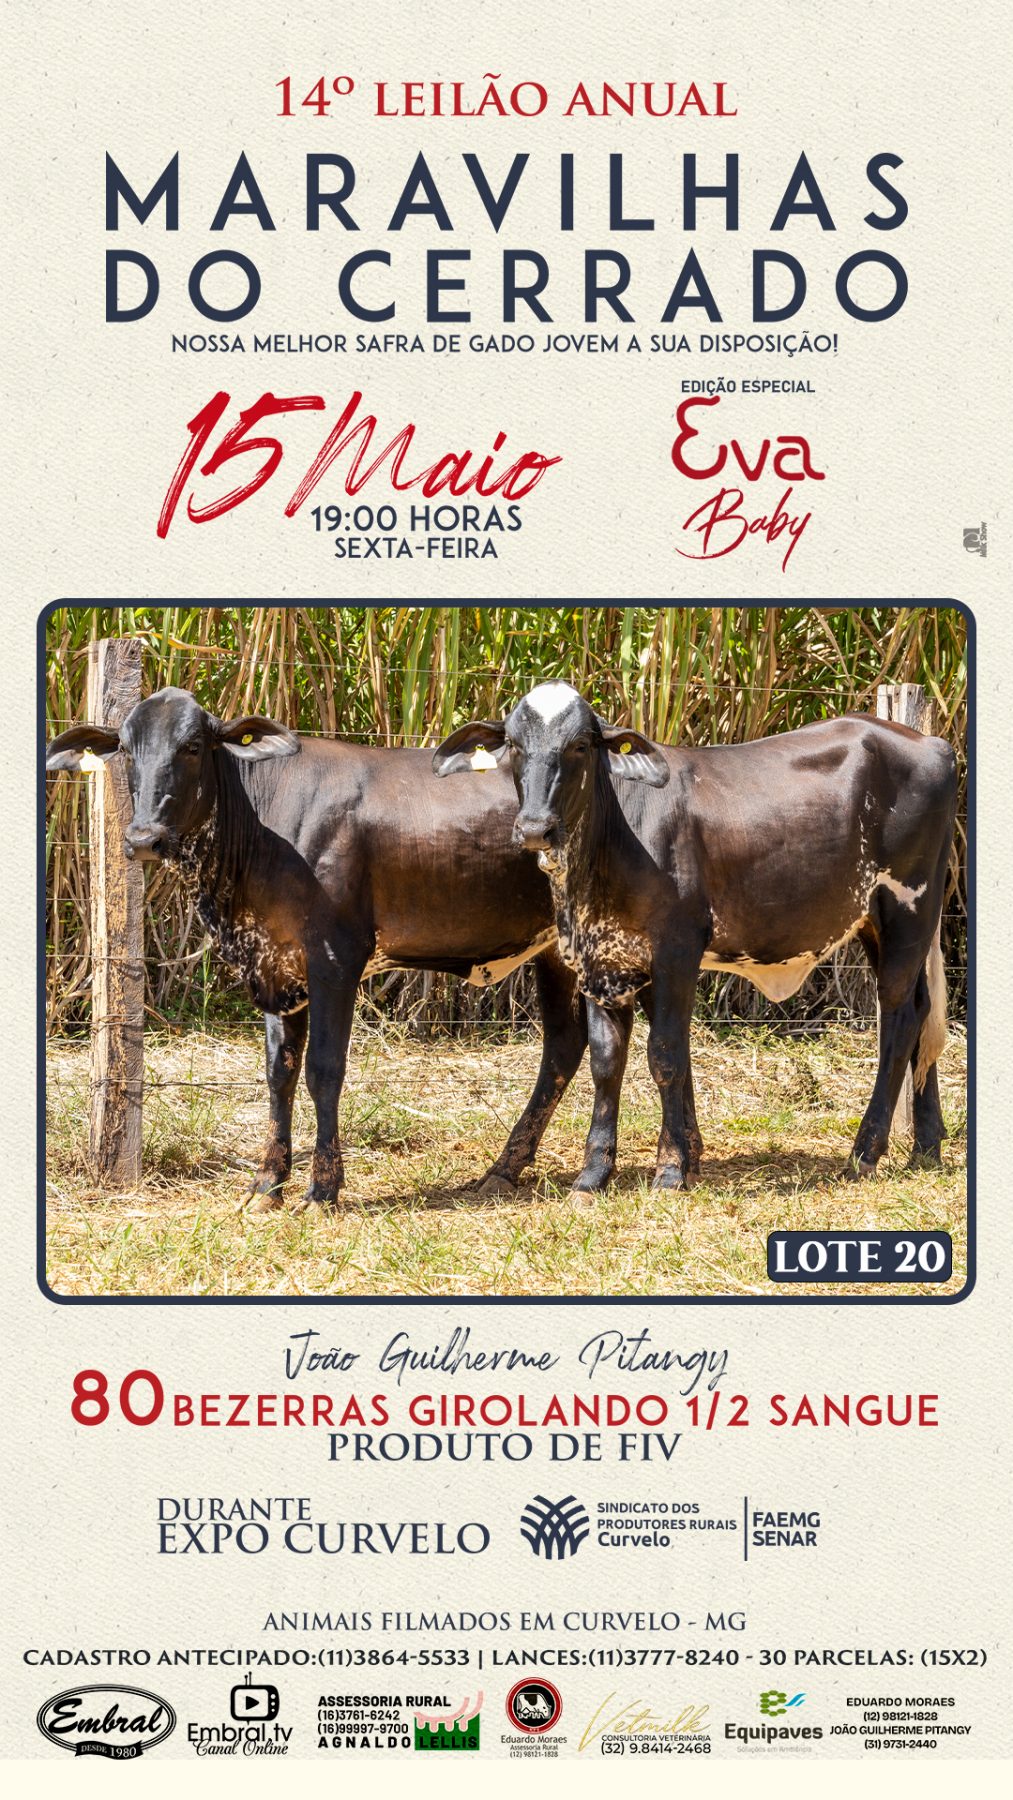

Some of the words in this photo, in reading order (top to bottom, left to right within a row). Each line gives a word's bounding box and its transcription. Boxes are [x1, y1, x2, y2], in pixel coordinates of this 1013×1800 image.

[373, 72, 549, 117] LEILÃO
[562, 81, 738, 117] ANUAL
[105, 150, 909, 234] MARAVILHAS
[105, 249, 262, 323] DO
[338, 247, 909, 323] CERRADO
[171, 334, 246, 353] NOSSA
[253, 334, 348, 353] MELHOR
[355, 334, 426, 353] SAFRA
[433, 334, 461, 353] DE
[468, 334, 535, 353] GADO
[542, 334, 619, 353] JOVEM
[626, 334, 642, 353] A
[650, 334, 692, 353] SUA
[700, 330, 838, 358] DISPOSIÇÃO!
[681, 376, 737, 398] EDIÇÃO
[741, 379, 816, 393] ESPECIAL
[671, 396, 826, 481] Eva
[156, 391, 326, 540] 15
[284, 391, 562, 517] Maio
[310, 504, 398, 532] 19:00
[410, 504, 523, 532] HORAS
[675, 486, 812, 573] Baby
[334, 536, 499, 559] SEXTA-FEIRA
[774, 1239, 882, 1274] LOTE
[893, 1239, 946, 1275] 20
[283, 1331, 361, 1380] João
[378, 1329, 560, 1375] Guilherme
[577, 1328, 731, 1397] Pitangy
[70, 1369, 165, 1427] 80
[173, 1393, 390, 1427] BEZERRAS
[408, 1393, 669, 1427] GIROLANDO
[686, 1393, 751, 1431] 1/2
[769, 1393, 939, 1427] SANGUE
[327, 1432, 533, 1462] PRODUTO
[548, 1432, 602, 1462] DE
[618, 1433, 683, 1462] FIV
[157, 1497, 312, 1521] DURANTE
[597, 1502, 669, 1514] SINDICATO
[672, 1503, 700, 1514] DOS
[597, 1518, 686, 1531] PRODUTORES
[689, 1519, 738, 1531] RURAIS
[752, 1511, 821, 1528] FAEMG
[157, 1522, 269, 1554] EXPO
[284, 1522, 491, 1554] CURVELO
[597, 1530, 671, 1548] Curvelo
[752, 1530, 818, 1547] SENAR
[262, 1611, 372, 1631] ANIMAIS
[382, 1611, 511, 1631] FILMADOS
[520, 1612, 555, 1631] EM
[563, 1611, 681, 1631] CURVELO
[705, 1611, 746, 1631] MG
[22, 1649, 151, 1666] CADASTRO
[759, 1649, 787, 1666] 30
[794, 1649, 914, 1666] PARCELAS:
[920, 1648, 988, 1668] (15X2)
[317, 1695, 403, 1708] ASSESSORIA
[405, 1695, 452, 1708] RURAL
[846, 1697, 903, 1707] EDUARDO
[905, 1697, 956, 1707] MORAES
[48, 1698, 164, 1734] Embral
[317, 1708, 401, 1722] (16)3761-6242
[578, 1691, 712, 1752] Vetmilk
[863, 1711, 881, 1723] (12)
[881, 1711, 939, 1722] 98121-1828
[317, 1722, 409, 1736] (16)99997-9700
[500, 1734, 536, 1744] Eduardo
[537, 1735, 568, 1744] Moraes
[601, 1734, 658, 1742] CONSULTORIA
[724, 1722, 824, 1744] Equipaves
[829, 1723, 858, 1735] JOÃO
[858, 1725, 924, 1736] GUILHERME
[924, 1725, 972, 1736] PITANGY
[80, 1743, 108, 1754] DESDE
[109, 1745, 137, 1758] 1980
[192, 1737, 240, 1756] Canal
[241, 1737, 290, 1756] Online
[317, 1735, 412, 1749] AGNALDO
[419, 1736, 478, 1749] LELLIS
[600, 1741, 625, 1756] (32)
[629, 1742, 712, 1754] 9.8414-2468
[864, 1738, 882, 1751] (31)
[882, 1739, 938, 1750] 9731-2440
[509, 1750, 520, 1758] (12)
[523, 1750, 559, 1758] 98121-1828
